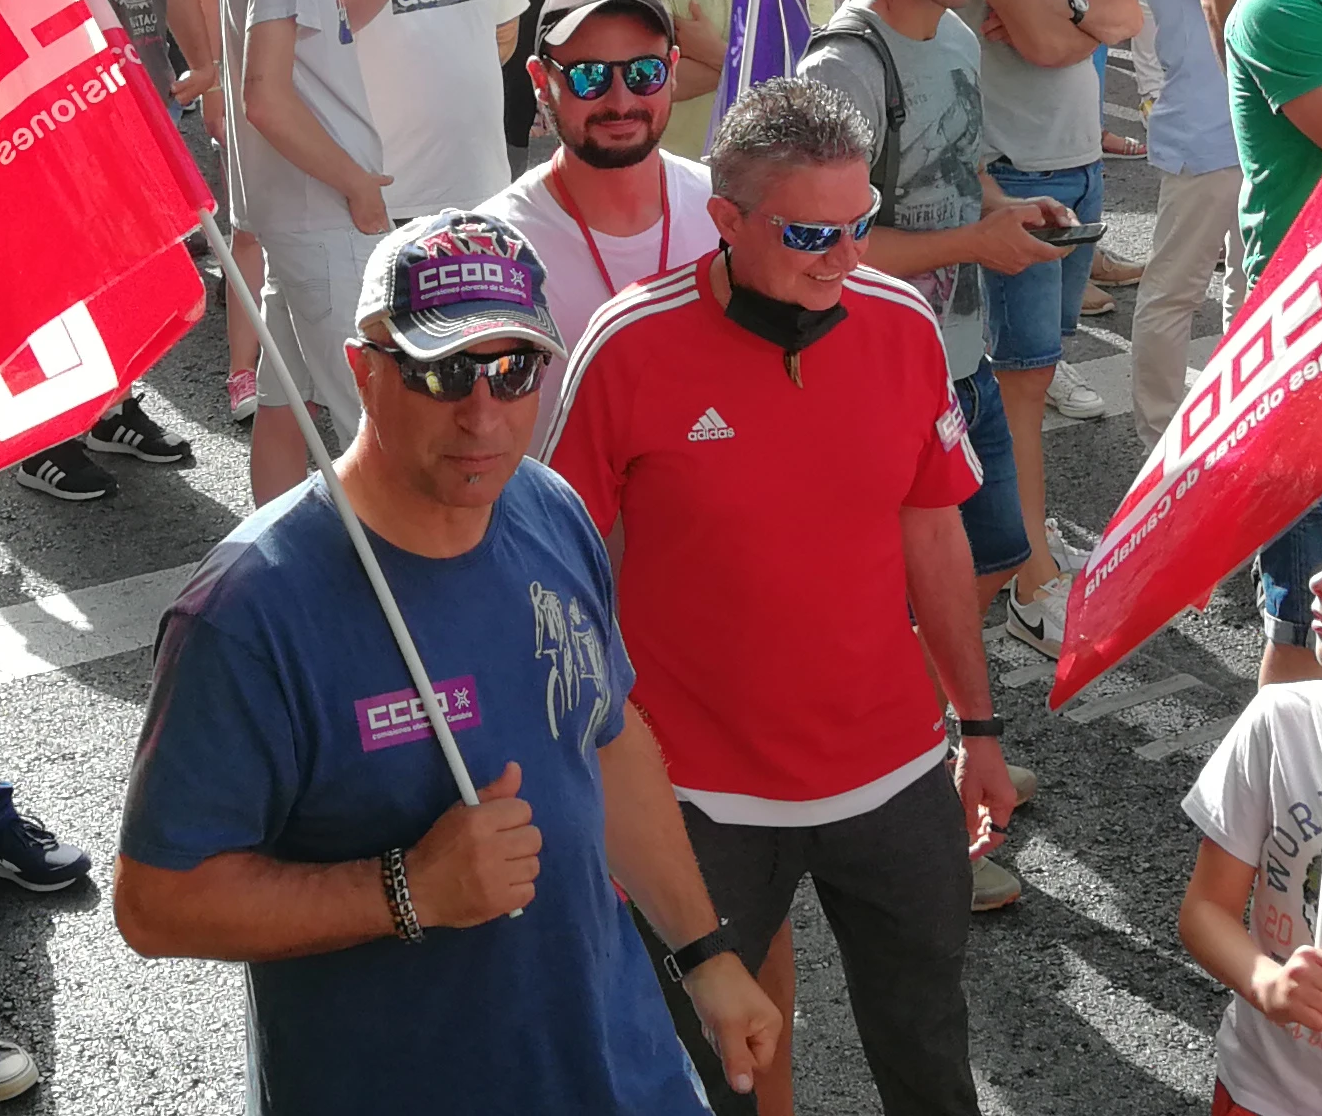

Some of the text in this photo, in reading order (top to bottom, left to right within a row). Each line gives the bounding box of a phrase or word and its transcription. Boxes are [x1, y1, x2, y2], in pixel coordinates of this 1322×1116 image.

[418, 262, 504, 291] CCOO
[687, 427, 735, 442] adidas
[1264, 905, 1294, 947] 20
